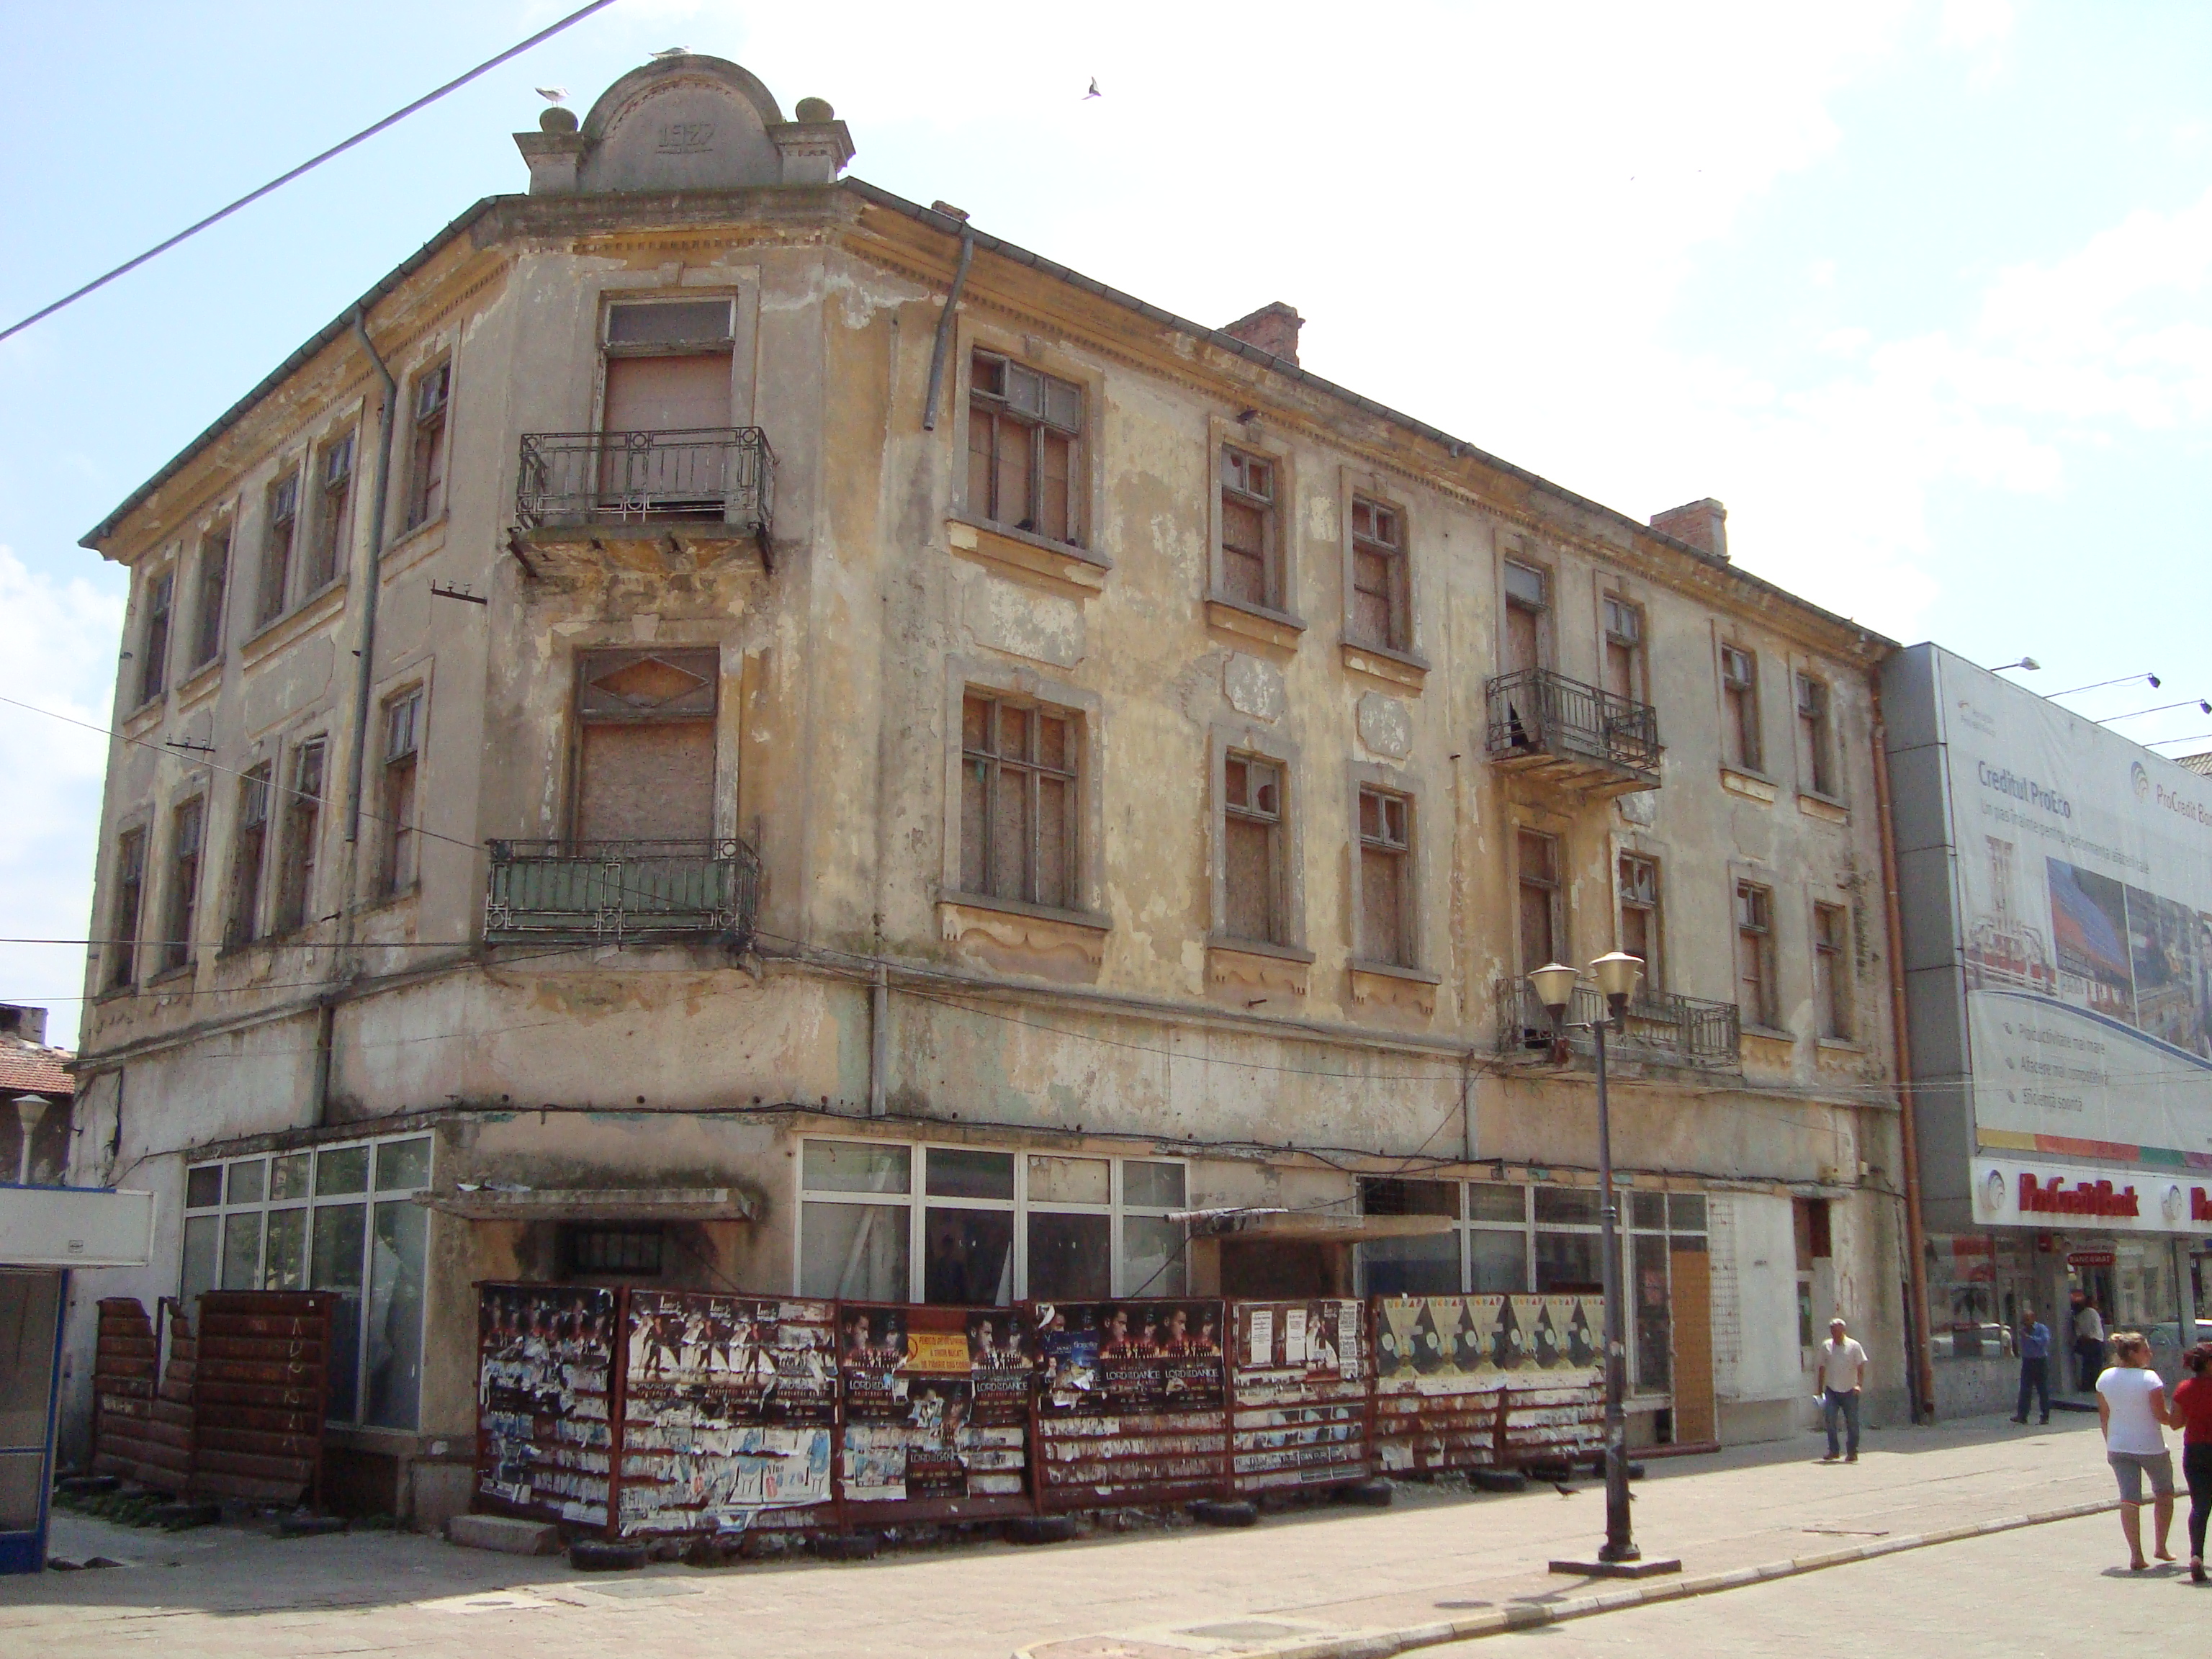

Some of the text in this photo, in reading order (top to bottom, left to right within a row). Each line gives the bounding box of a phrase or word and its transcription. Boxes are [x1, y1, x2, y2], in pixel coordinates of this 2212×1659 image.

[1978, 760, 2028, 801] Creditul
[2157, 783, 2196, 821] ProCredit
[1105, 1371, 1127, 1380] LORD
[1133, 1370, 1161, 1380] DANCE
[1193, 1368, 1219, 1378] DANCE
[976, 1382, 997, 1392] LORD
[1002, 1381, 1028, 1391] DANCE
